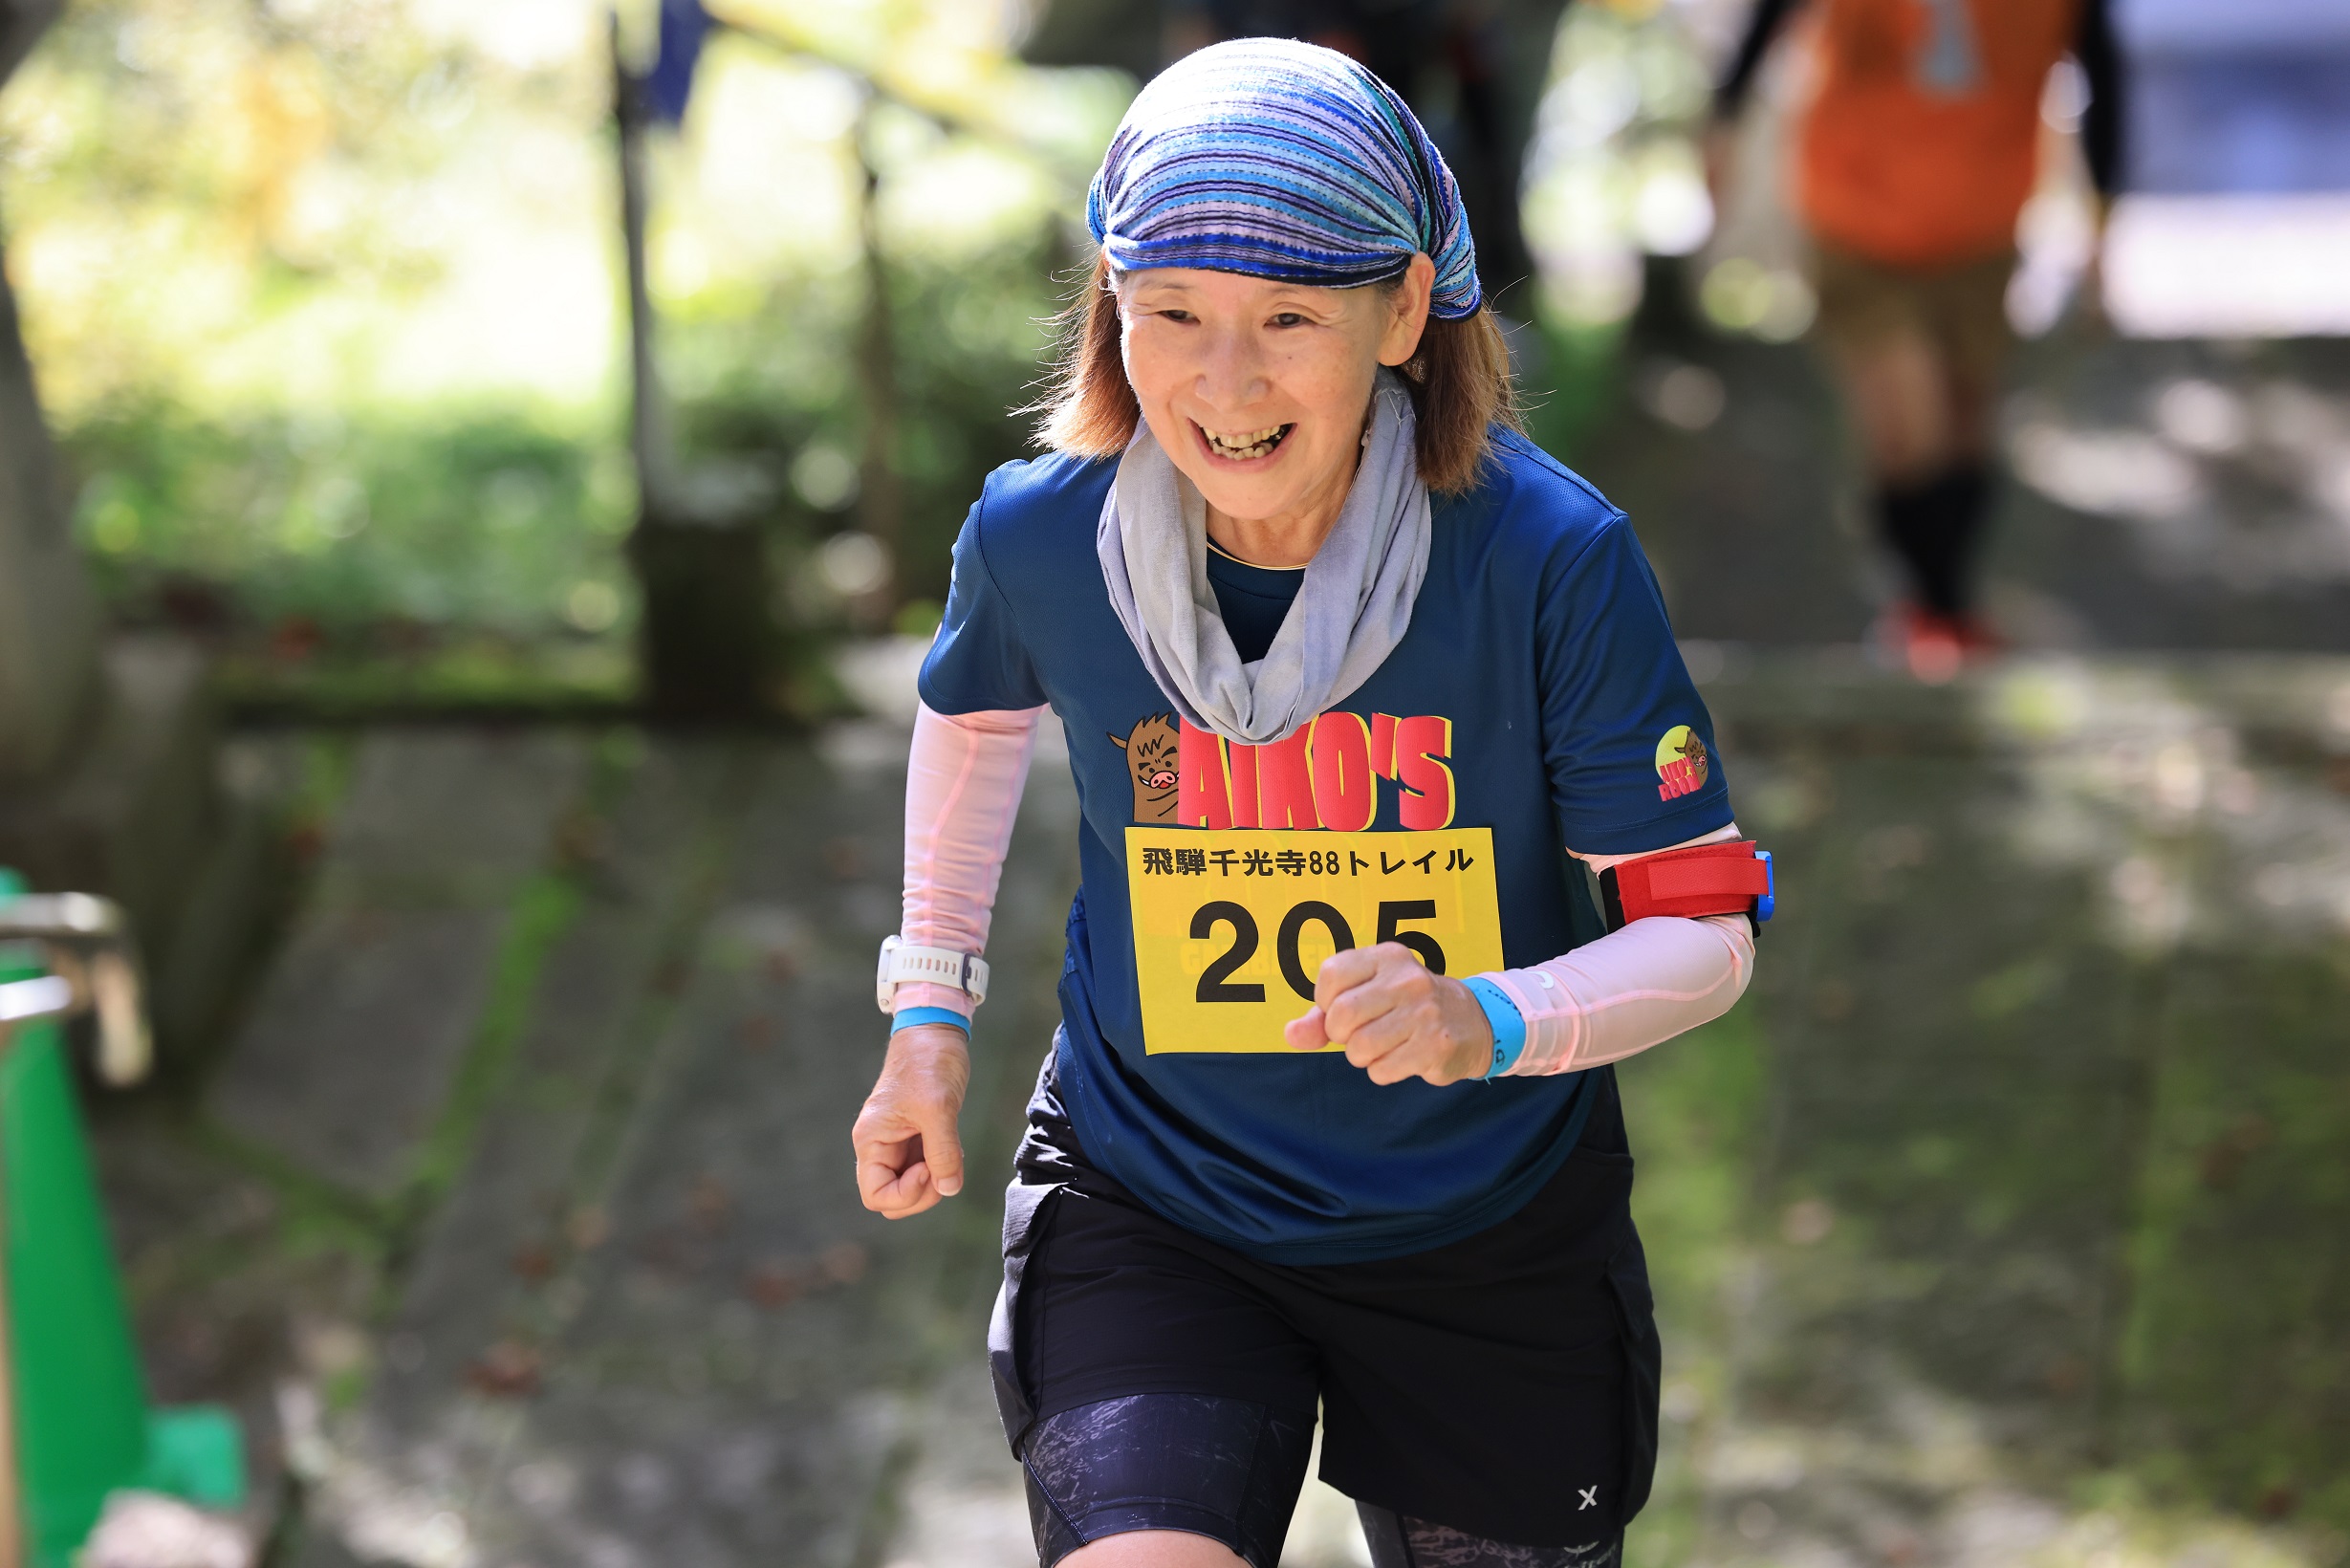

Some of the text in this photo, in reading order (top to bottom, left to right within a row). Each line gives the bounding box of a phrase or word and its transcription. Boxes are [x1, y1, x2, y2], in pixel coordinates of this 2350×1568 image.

[1178, 711, 1455, 831] AIKO'S
[1658, 774, 1702, 801] ROOM
[1142, 847, 1474, 877] 飛騨千光寺88トレイル
